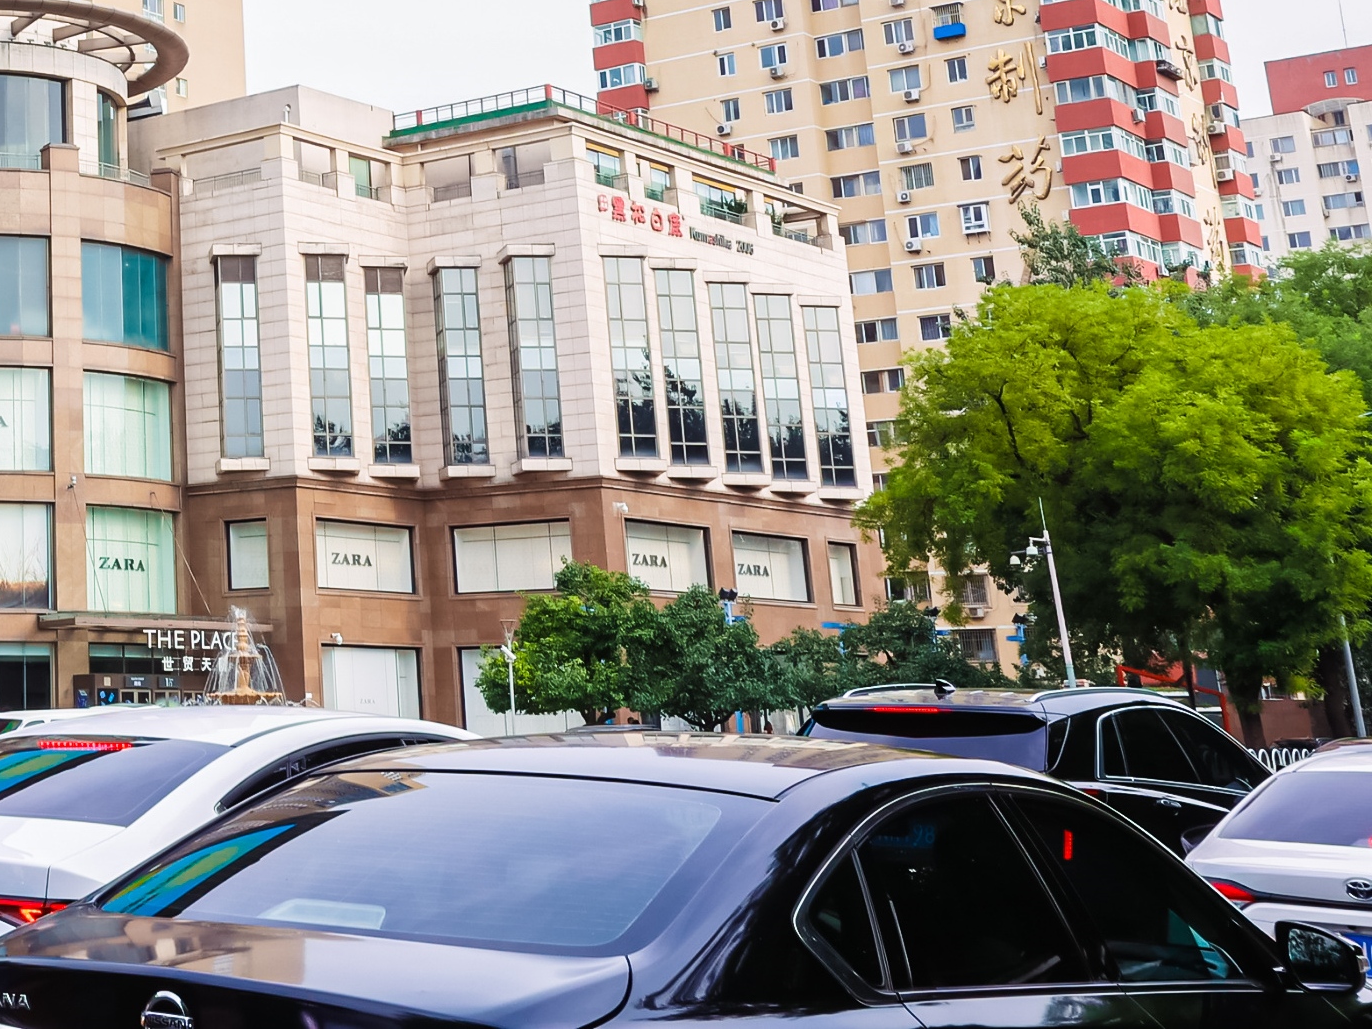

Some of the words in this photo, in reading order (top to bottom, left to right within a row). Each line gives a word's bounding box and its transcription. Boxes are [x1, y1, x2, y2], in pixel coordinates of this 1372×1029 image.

[98, 556, 146, 572] ZARA
[331, 551, 373, 567] ZARA
[631, 552, 668, 568] ZARA
[737, 562, 770, 578] ZARA
[142, 628, 185, 650] THE
